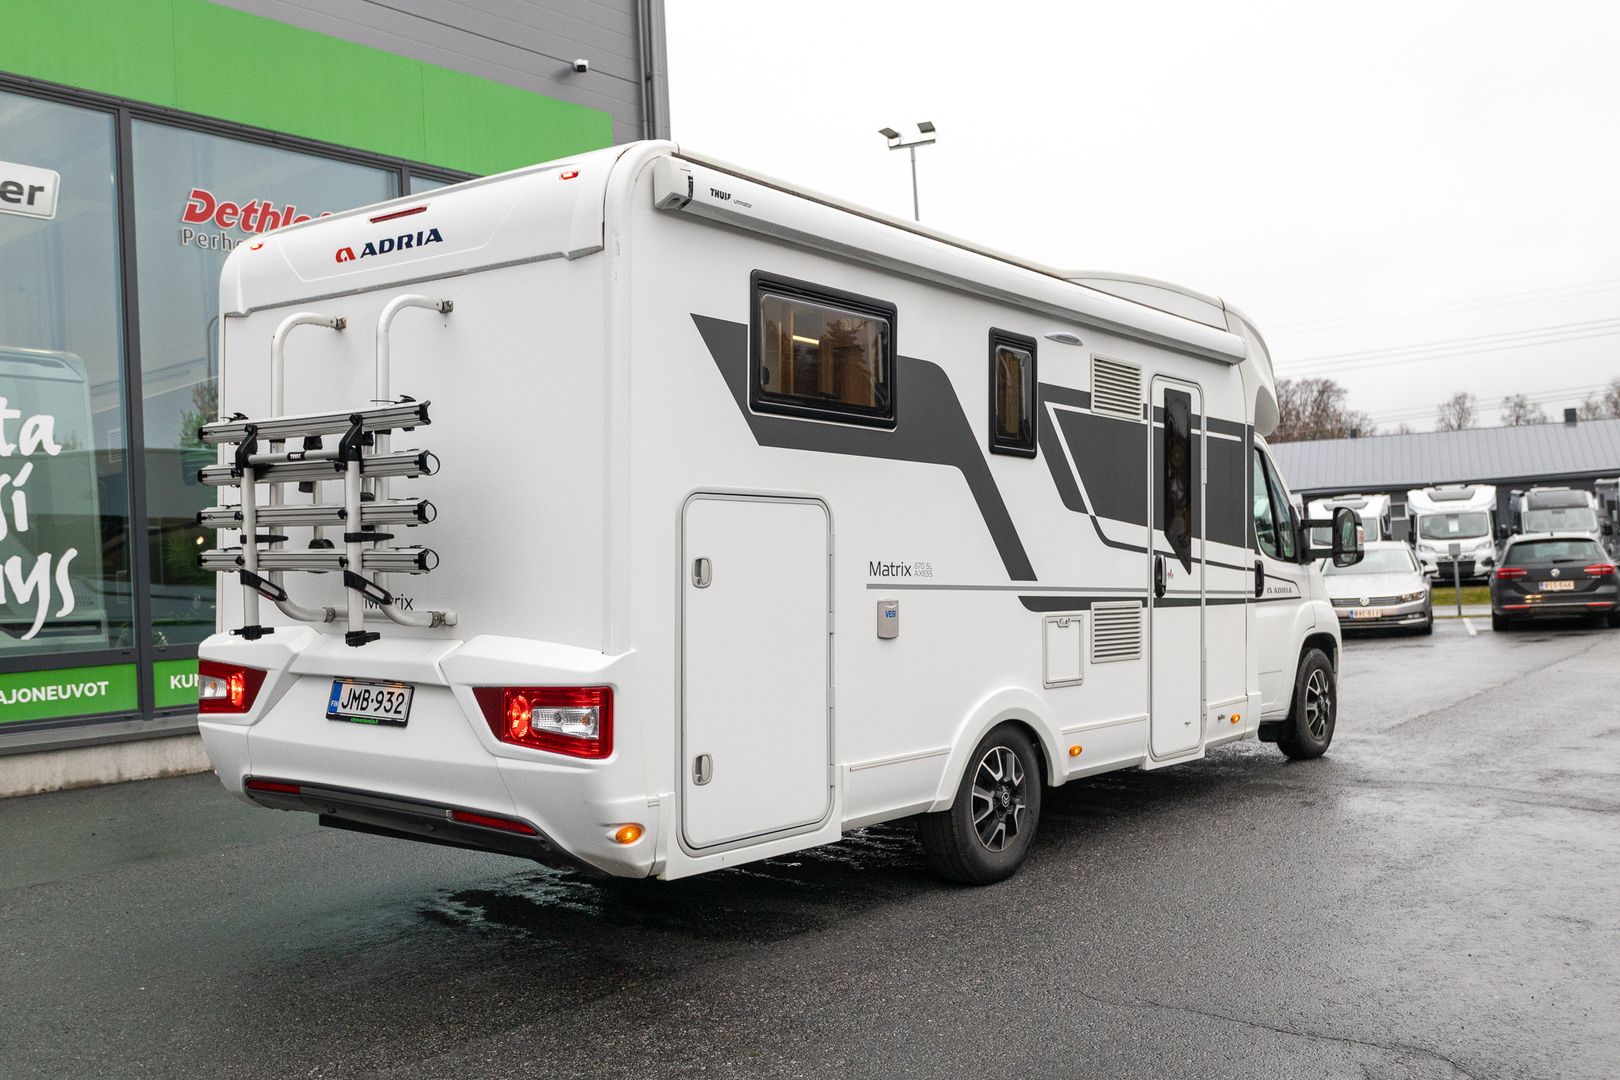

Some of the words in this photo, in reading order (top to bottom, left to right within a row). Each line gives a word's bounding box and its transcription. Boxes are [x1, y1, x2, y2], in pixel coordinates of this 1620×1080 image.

[360, 227, 444, 259] ADRIA
[869, 561, 912, 577] Matrix
[341, 688, 405, 714] JMB-932
